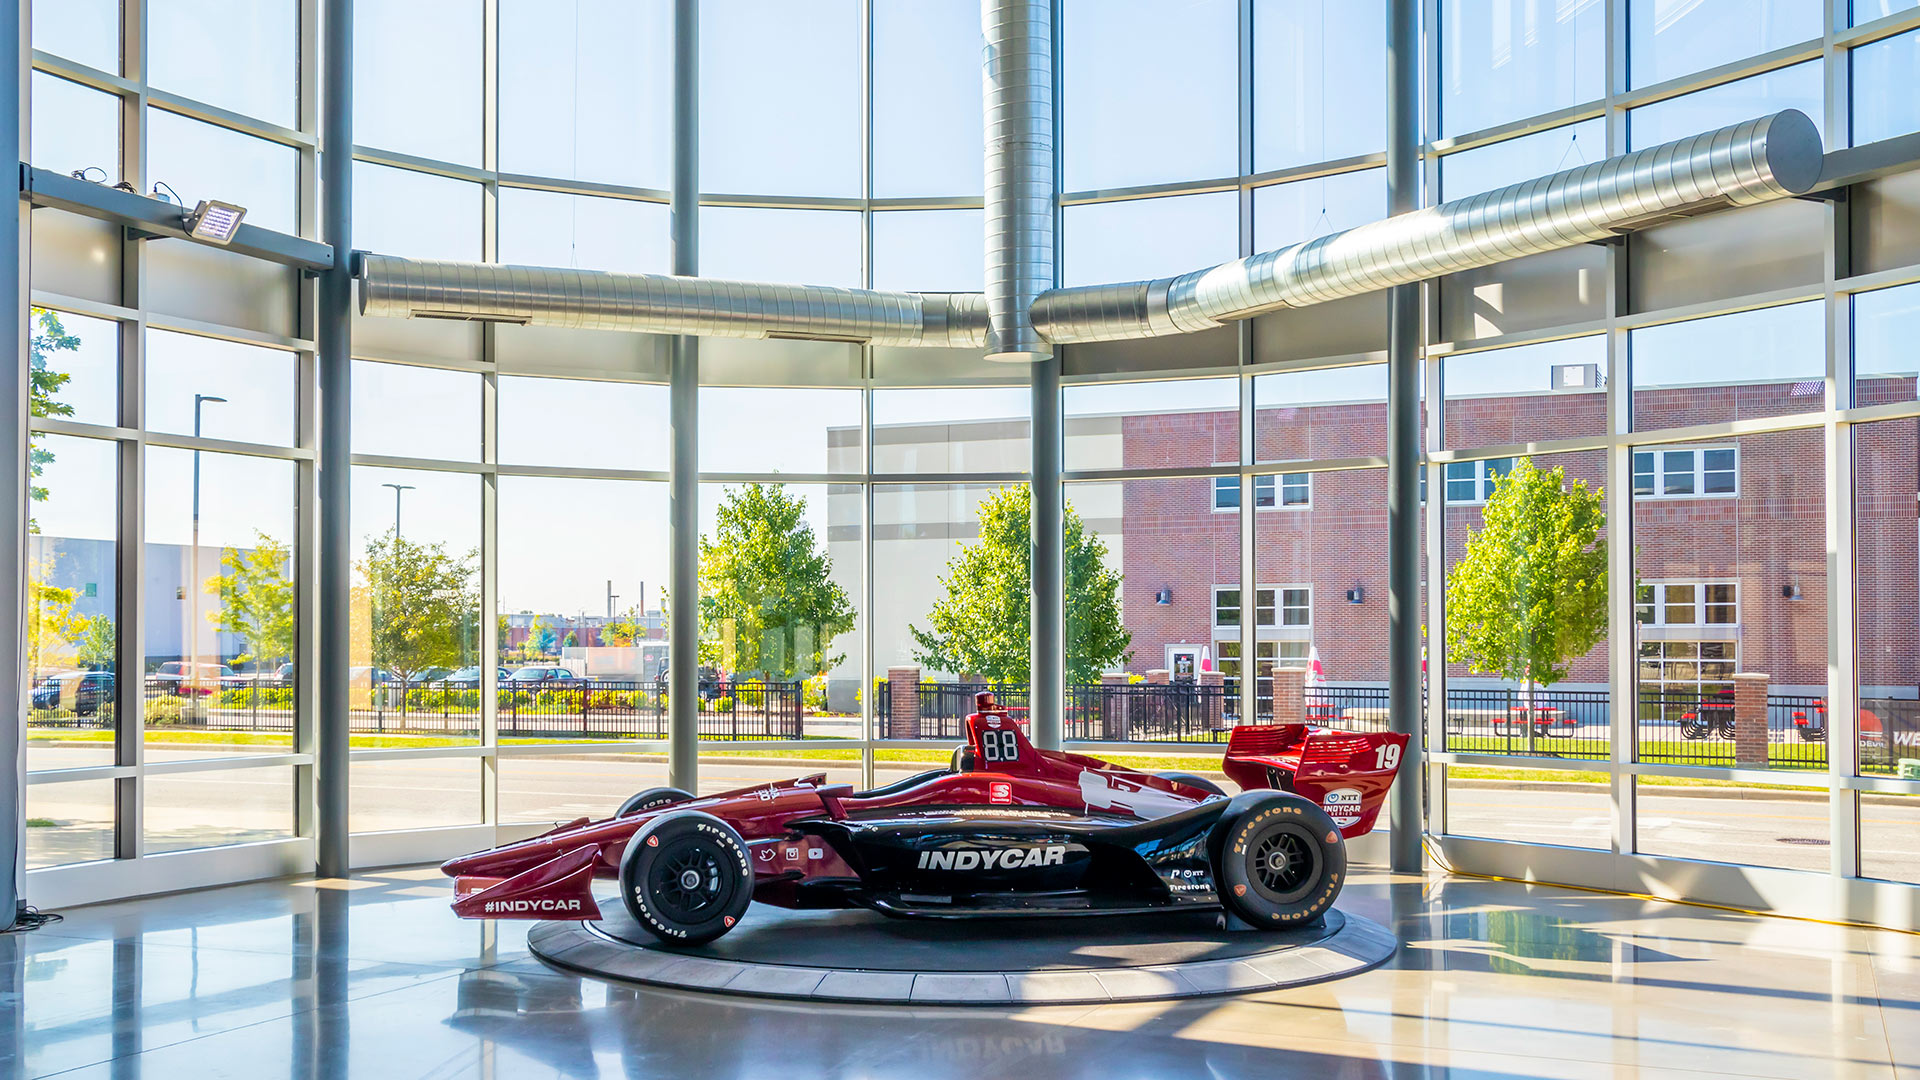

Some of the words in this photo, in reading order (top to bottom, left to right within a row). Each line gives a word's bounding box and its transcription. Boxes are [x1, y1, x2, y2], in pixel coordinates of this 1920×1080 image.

[1375, 743, 1401, 769] 19
[1233, 806, 1302, 853] Firestone
[697, 823, 749, 877] Firestone
[918, 845, 1066, 870] INDYCAR
[484, 899, 581, 912] #INDYCAR
[1169, 884, 1211, 892] Firestone
[1271, 872, 1339, 920] Firestone
[635, 886, 687, 938] Firestone
